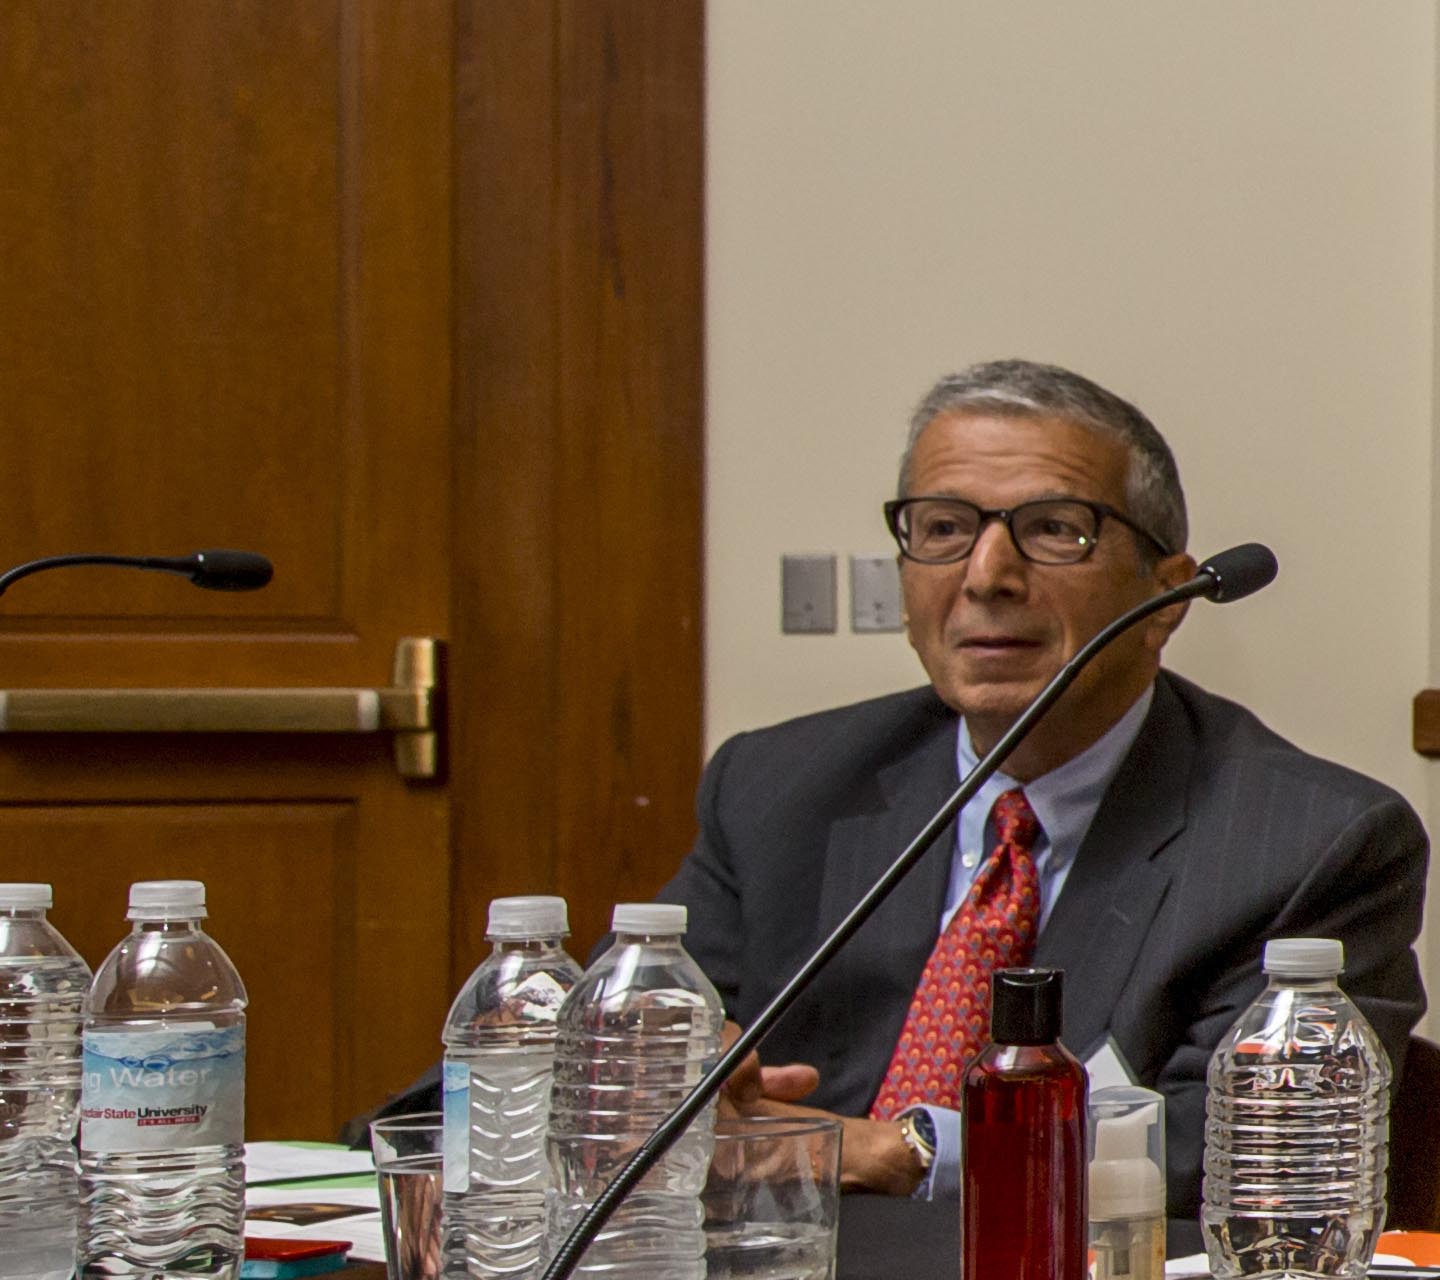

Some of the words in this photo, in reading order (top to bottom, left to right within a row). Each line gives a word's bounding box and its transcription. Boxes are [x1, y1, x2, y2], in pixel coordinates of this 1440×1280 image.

[110, 1067, 210, 1088] Water
[104, 1108, 136, 1119] State
[138, 1104, 207, 1118] University
